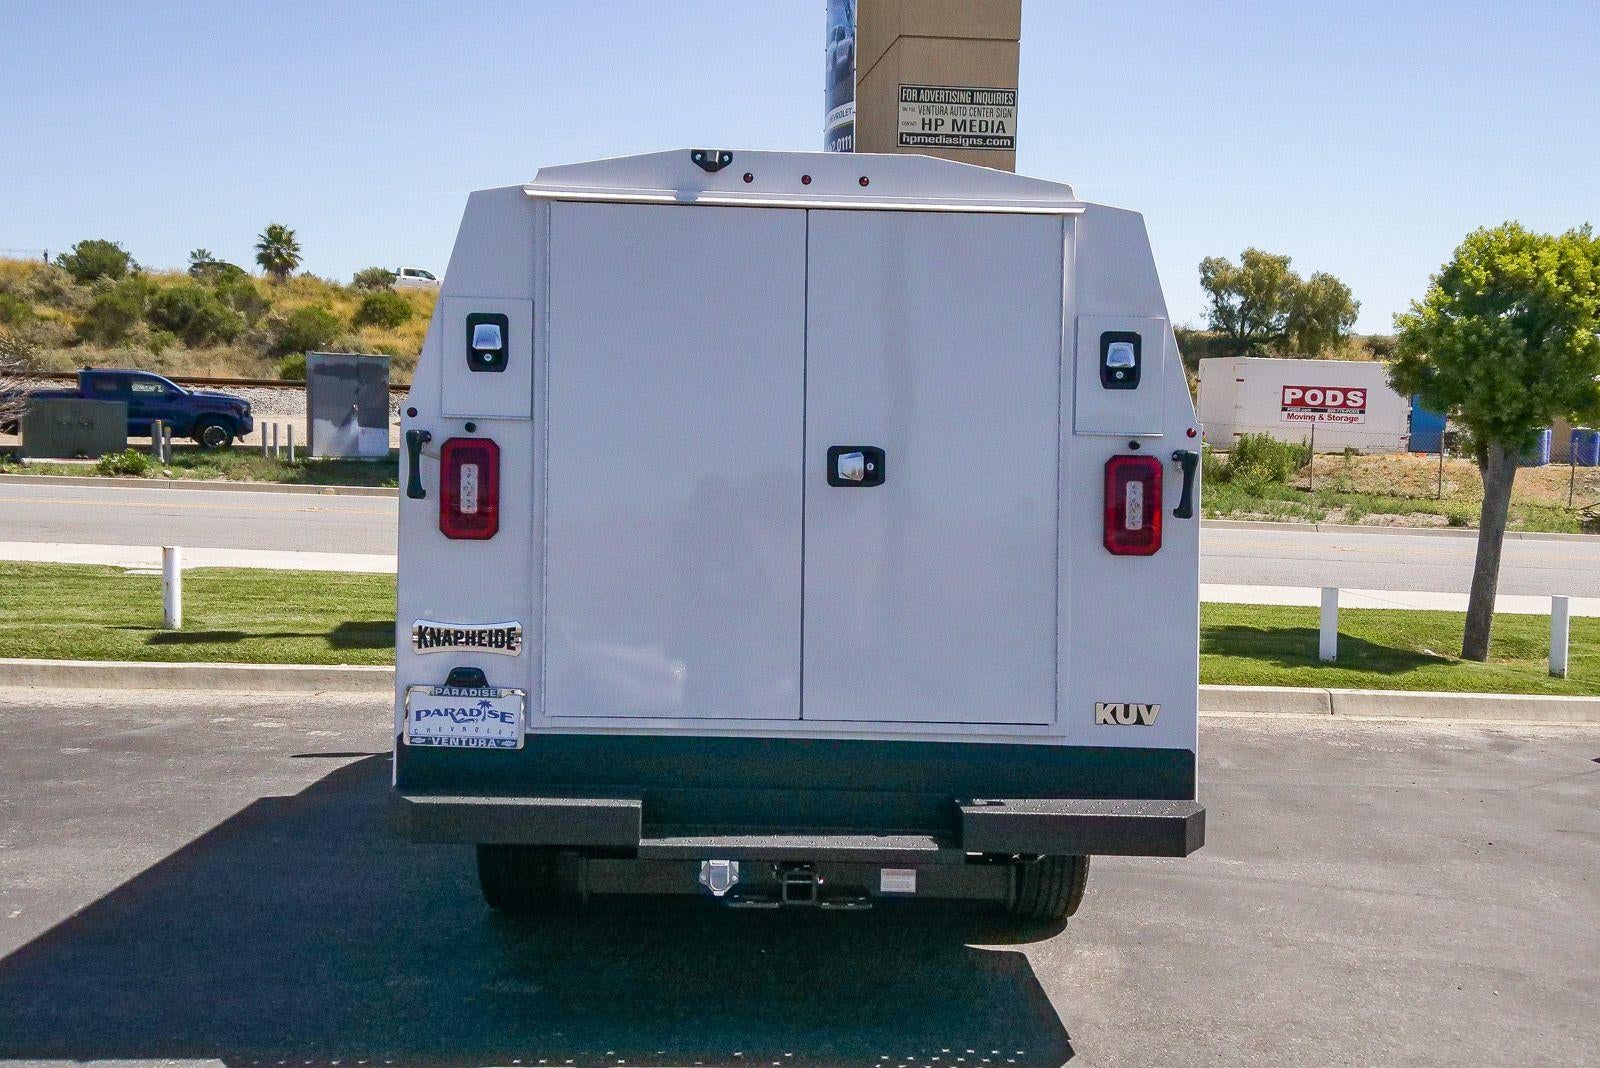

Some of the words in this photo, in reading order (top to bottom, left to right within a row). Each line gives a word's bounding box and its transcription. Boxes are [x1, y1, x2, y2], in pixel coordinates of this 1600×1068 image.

[902, 88, 918, 101] FOR
[919, 89, 972, 103] ADVERTISING
[973, 91, 1014, 106] INQUIRIES
[918, 104, 949, 117] VENTURA
[949, 105, 967, 117] AUTO
[968, 106, 995, 118] CENTER
[996, 107, 1013, 119] SIGN
[921, 117, 945, 131] HP
[951, 118, 1006, 134] MEDIA
[902, 133, 1011, 147] hpmediasigns.com
[1284, 388, 1364, 407] PODS
[1287, 412, 1316, 421] Moving
[1318, 413, 1325, 421] &
[1326, 414, 1360, 424] Storage
[417, 625, 517, 651] KNAPHEIDE
[435, 687, 498, 698] PARADISE
[415, 699, 516, 725] PARADISE
[1095, 702, 1161, 726] KUV
[414, 726, 515, 737] CHEVROLET
[431, 737, 497, 748] VENTURA
